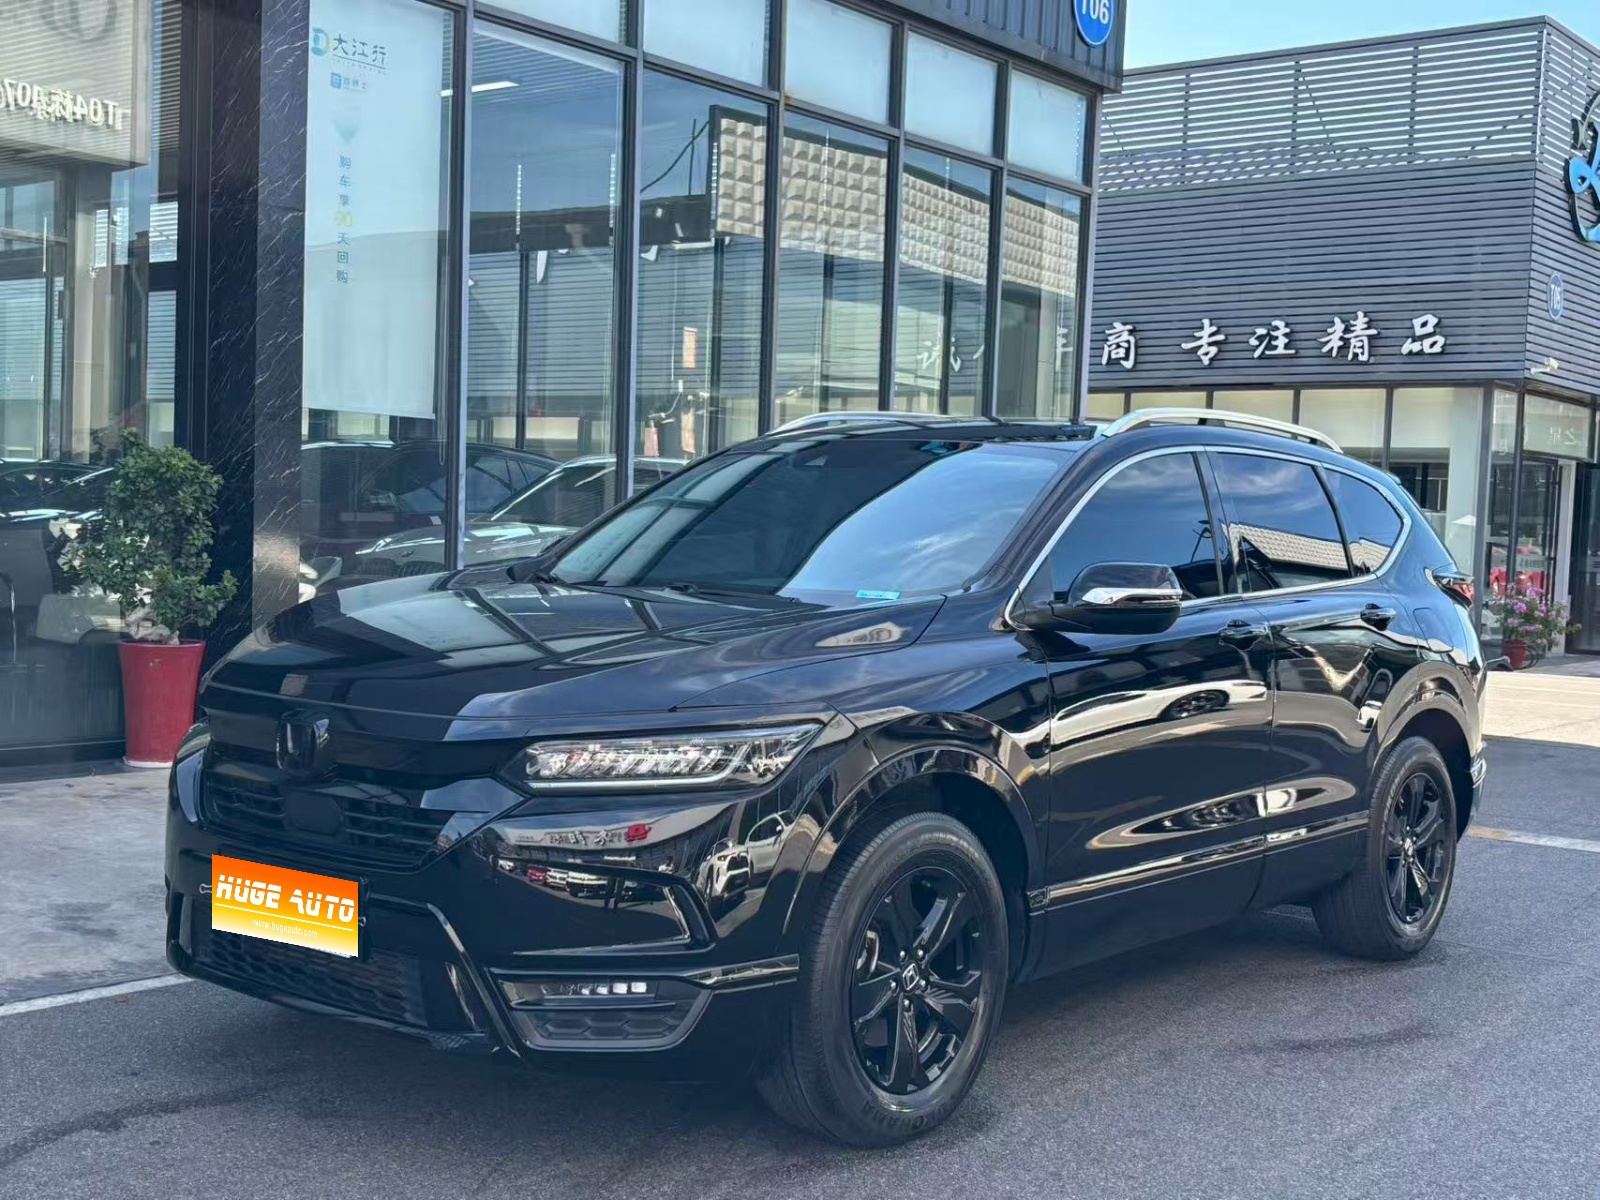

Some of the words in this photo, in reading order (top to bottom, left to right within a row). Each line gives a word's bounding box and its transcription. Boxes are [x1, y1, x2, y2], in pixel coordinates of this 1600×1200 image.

[332, 33, 386, 66] 大江行
[1181, 311, 1446, 363] 专注精品
[216, 874, 282, 909] HUGE
[289, 889, 355, 923] AUTO
[252, 918, 318, 938] www.hugeauto.com
